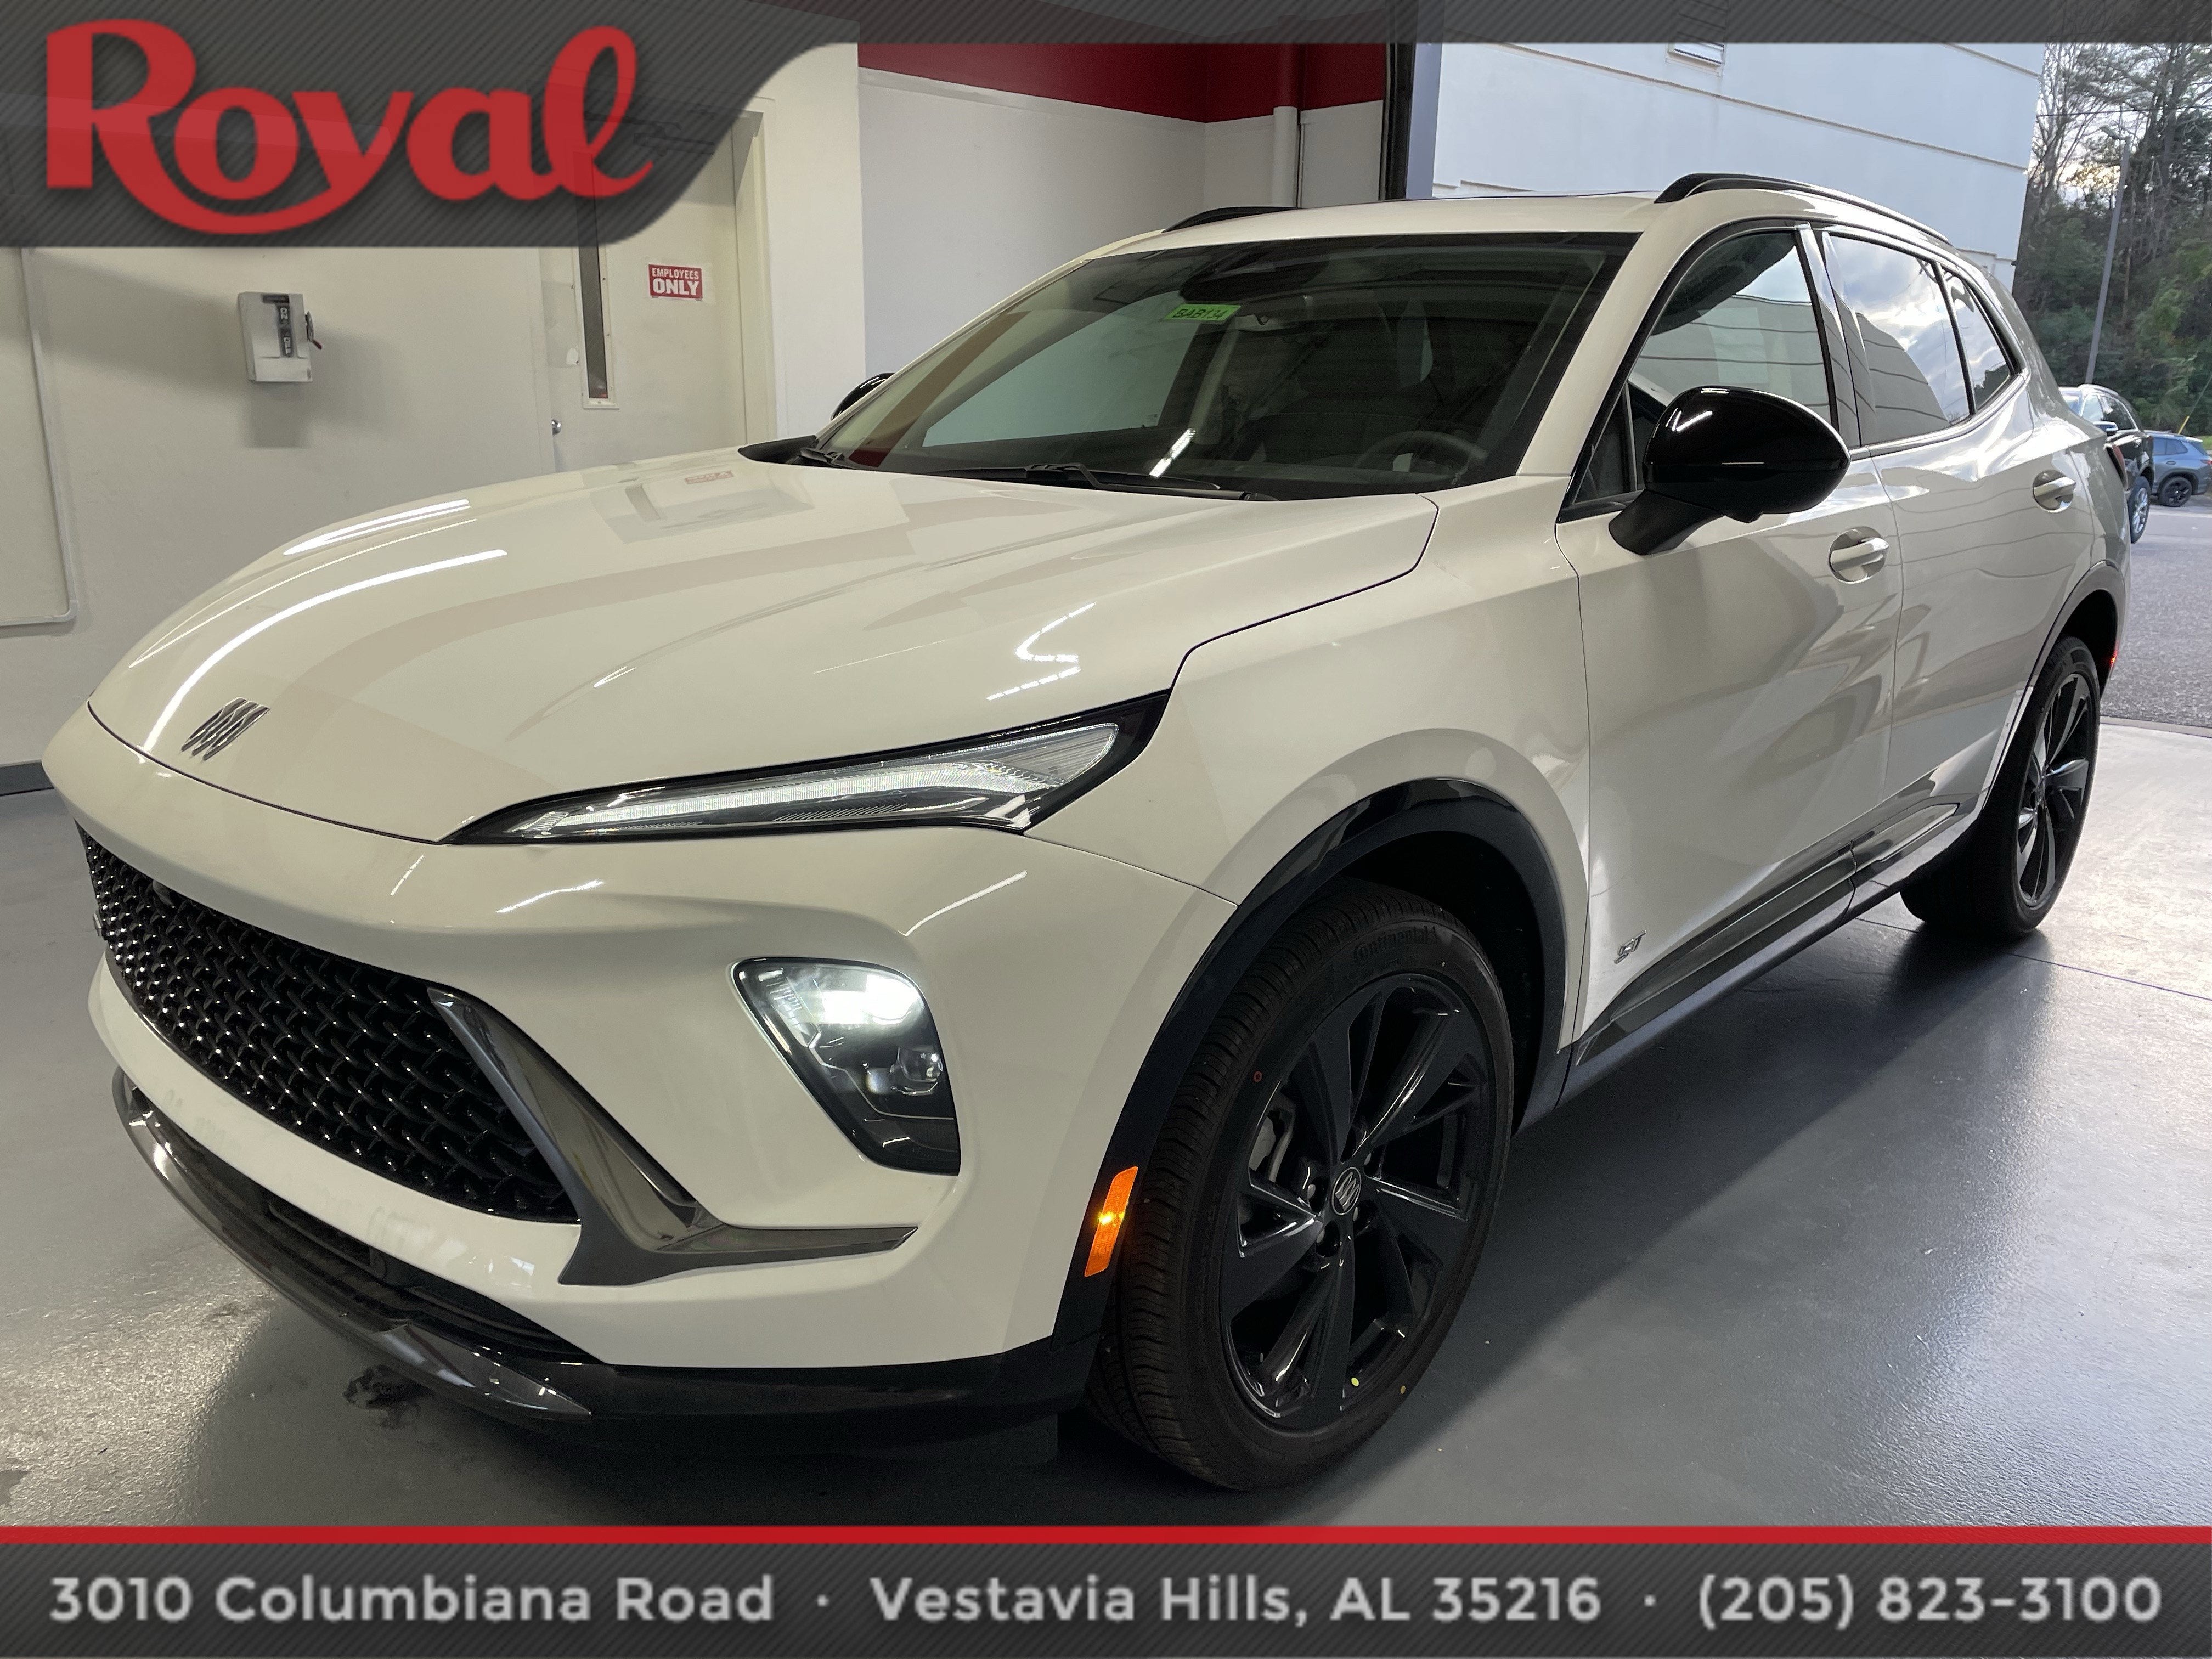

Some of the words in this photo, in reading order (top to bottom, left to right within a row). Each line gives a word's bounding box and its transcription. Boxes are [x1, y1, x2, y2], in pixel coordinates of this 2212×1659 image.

[652, 267, 699, 280] EMPLOYEES
[652, 278, 699, 296] ONLY
[1172, 308, 1228, 319] BAB134
[1353, 925, 1429, 965] Continental
[1613, 929, 1647, 964] ST
